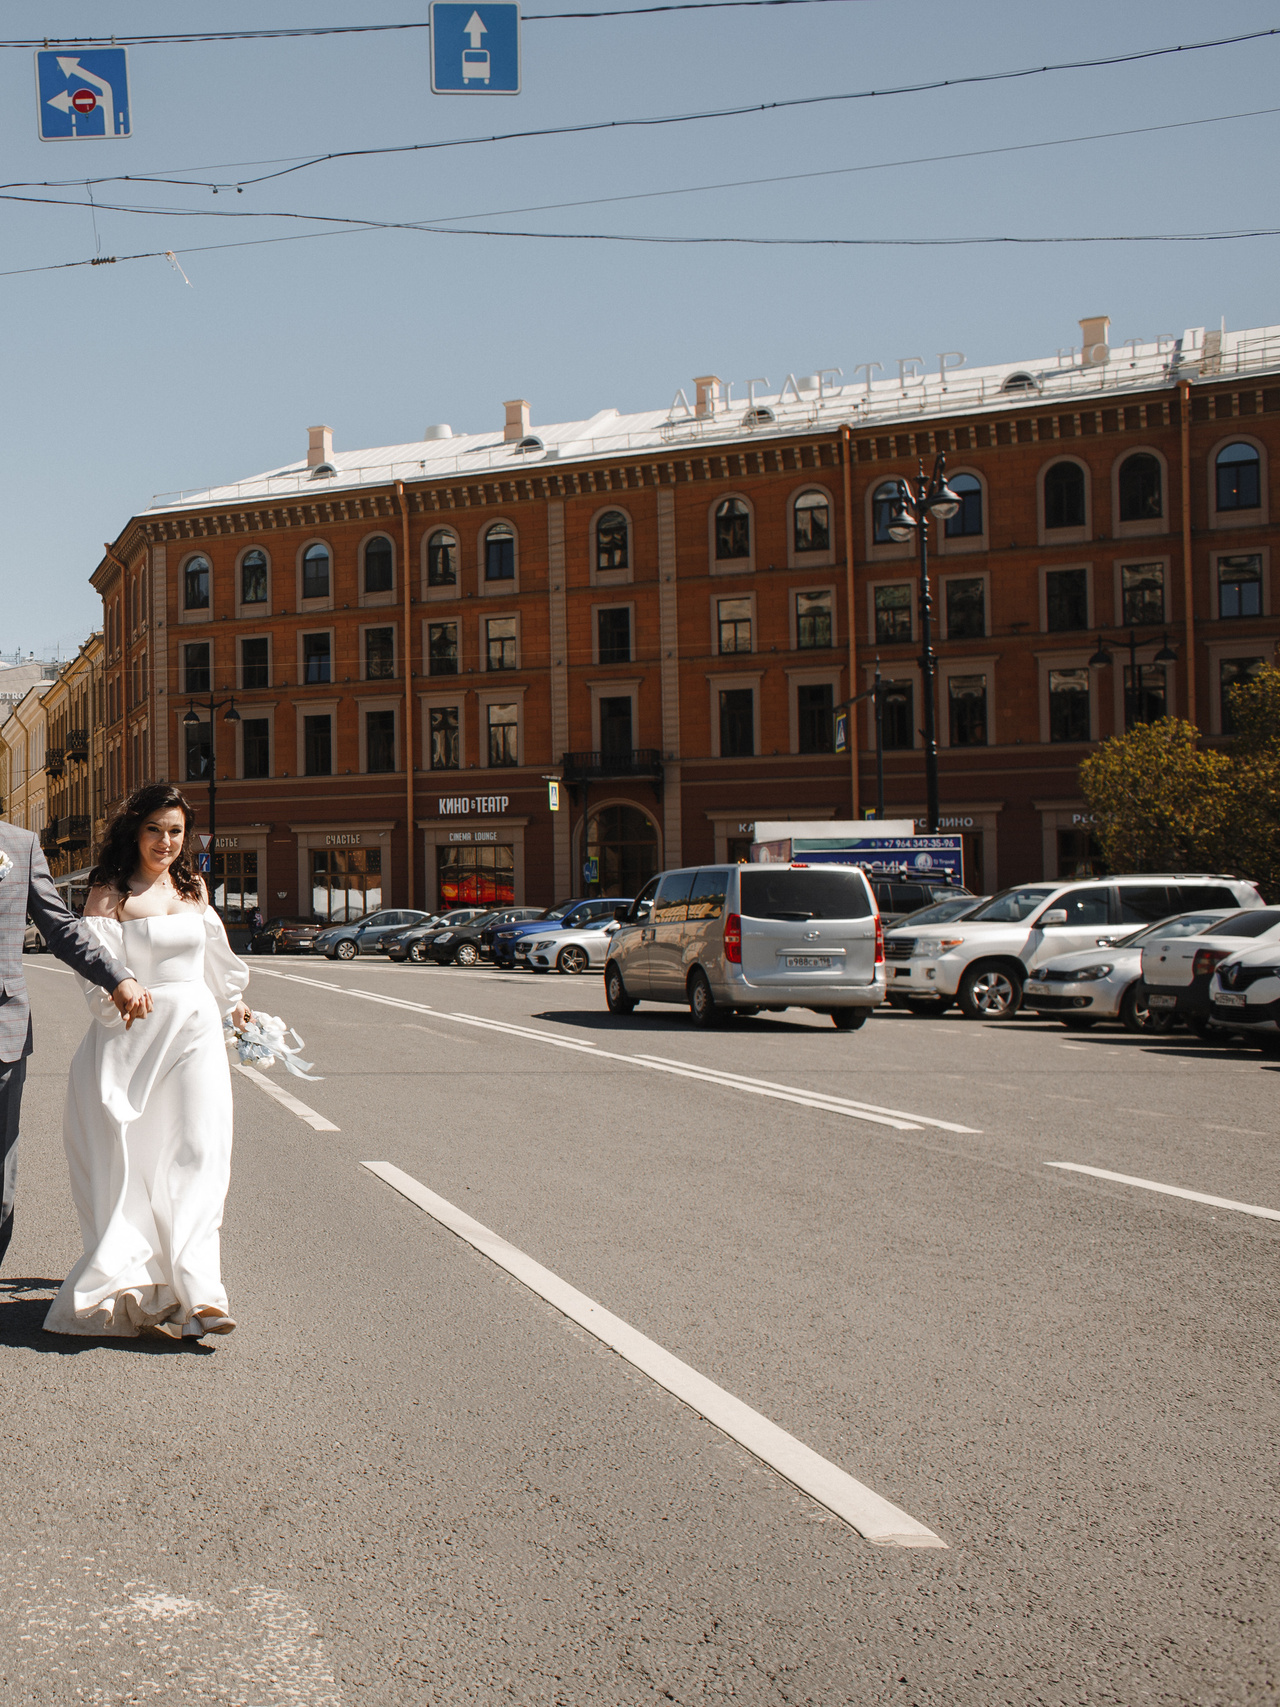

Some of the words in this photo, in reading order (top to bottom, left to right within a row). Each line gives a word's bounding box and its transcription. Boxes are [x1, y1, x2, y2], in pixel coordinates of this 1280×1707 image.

[669, 351, 967, 418] АНГЛЕТЕР
[325, 833, 361, 846] СЧАСТЬЕ
[449, 833, 472, 841] CINEMA
[474, 832, 498, 841] LOUNGE
[215, 837, 238, 848] АСТЬЕ
[884, 840, 894, 848] +7
[895, 839, 911, 848] 964
[913, 838, 955, 848] 342-35-96
